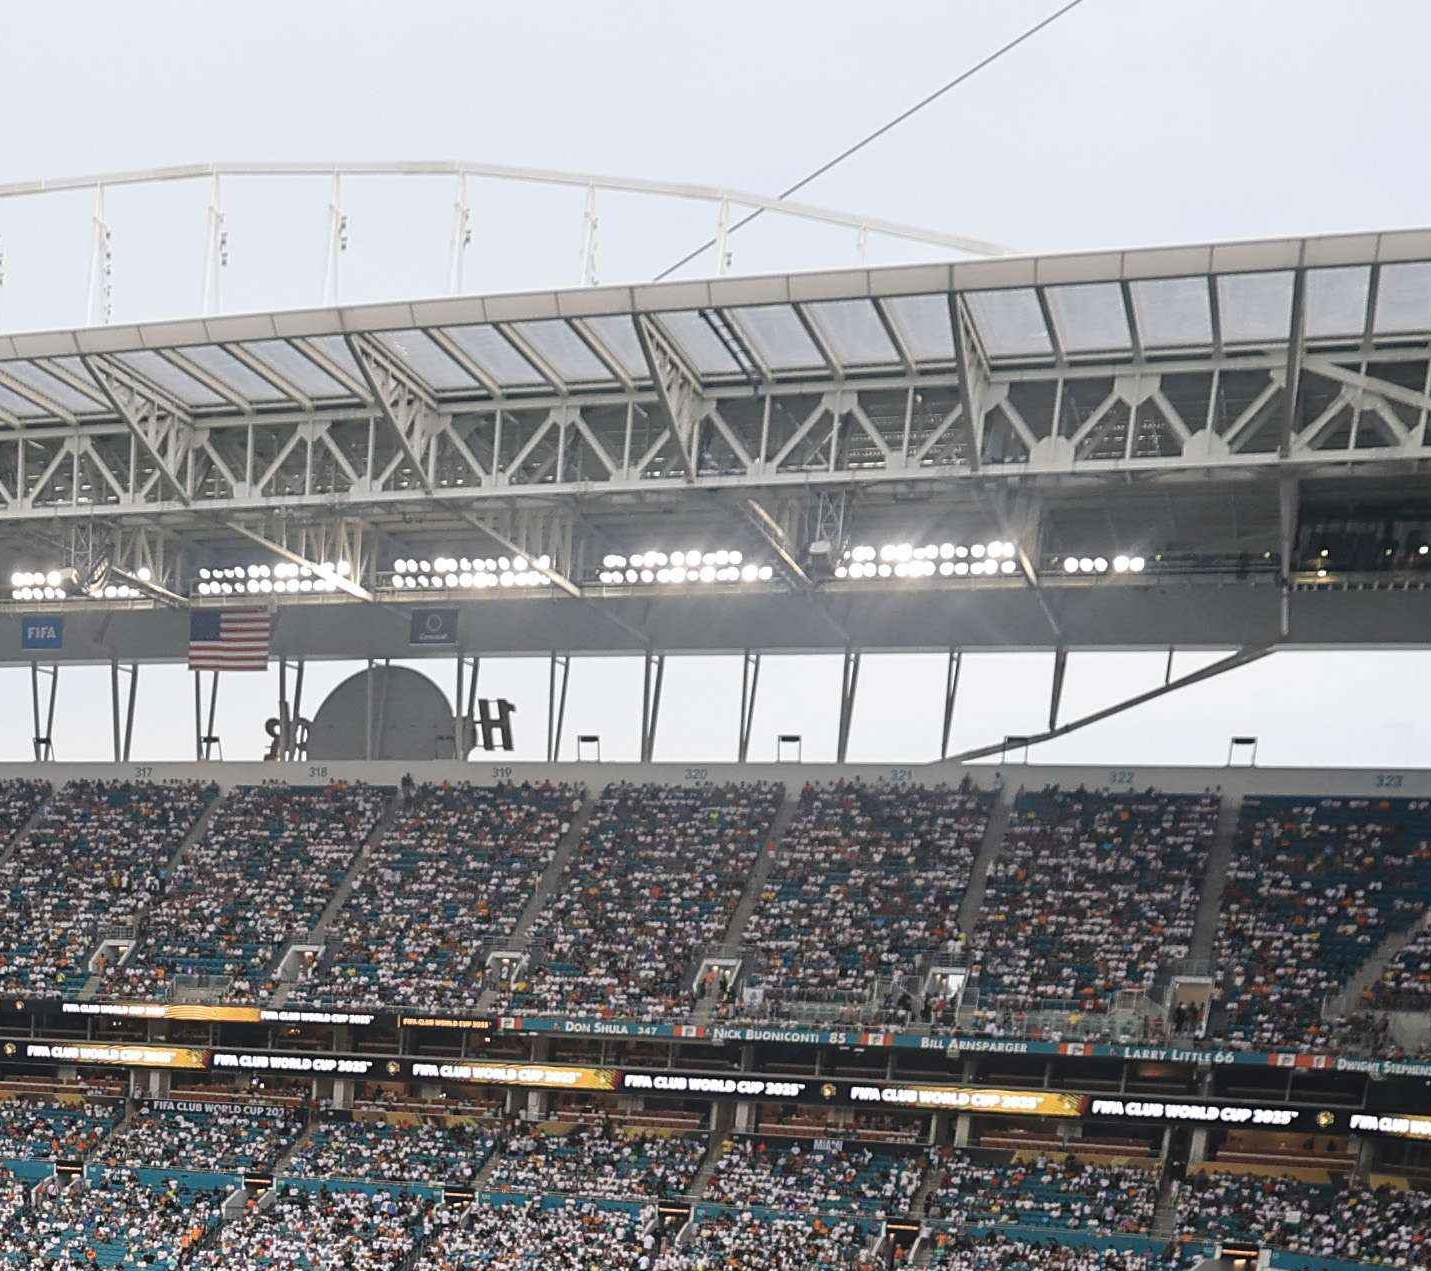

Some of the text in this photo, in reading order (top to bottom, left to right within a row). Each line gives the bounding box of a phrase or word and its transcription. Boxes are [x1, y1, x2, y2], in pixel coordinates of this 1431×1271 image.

[1214, 1050, 1235, 1064] 66
[624, 1075, 652, 1088] FIFA
[653, 1076, 687, 1090] CLUB
[689, 1078, 736, 1092] WORLD
[737, 1080, 764, 1094] CUP
